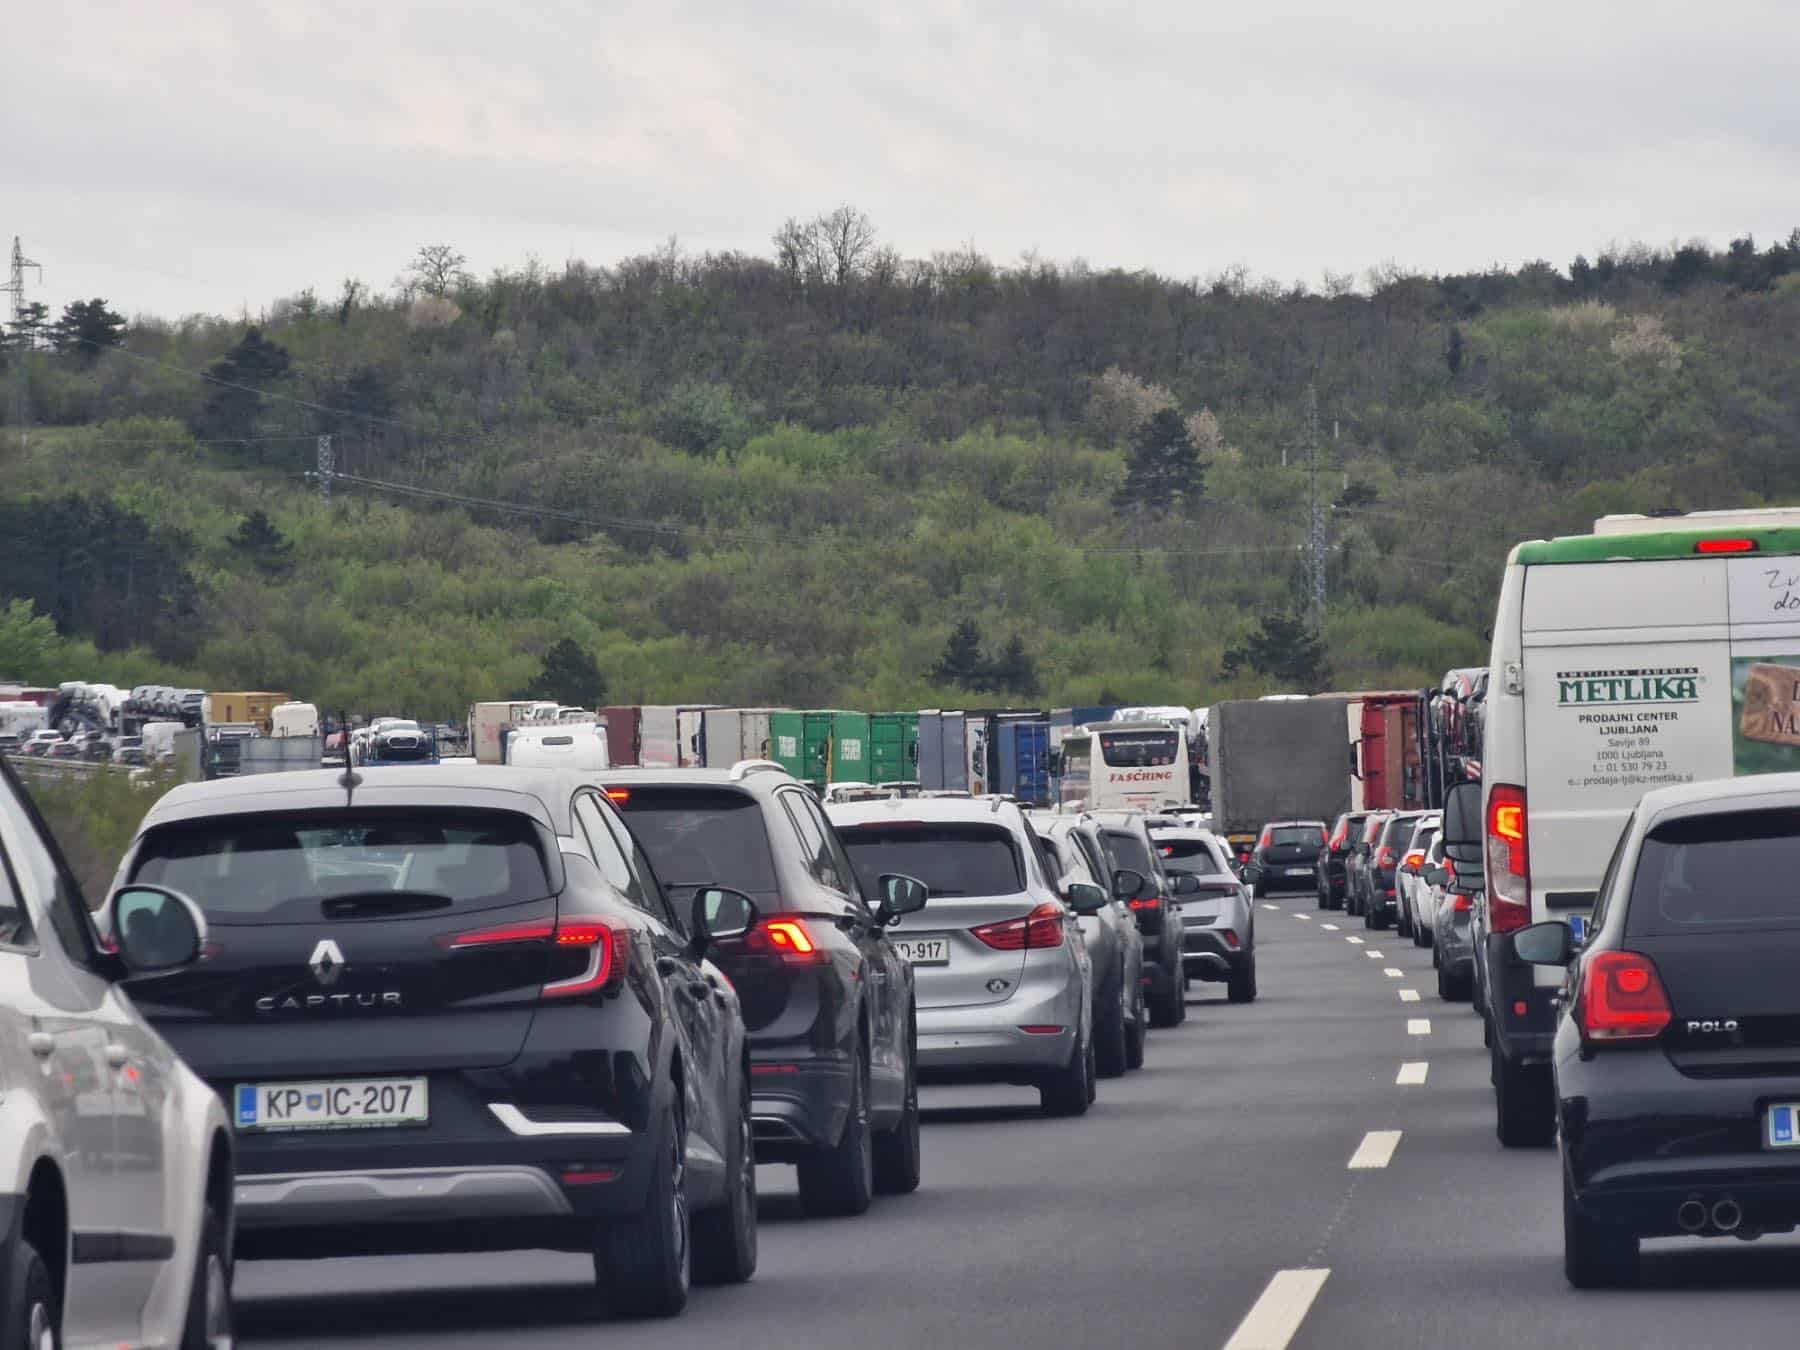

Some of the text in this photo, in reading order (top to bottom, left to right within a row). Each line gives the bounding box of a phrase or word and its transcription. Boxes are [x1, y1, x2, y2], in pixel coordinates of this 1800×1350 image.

[1558, 676, 1699, 703] METLIKA
[1578, 711, 1679, 723] PRODAJNI CENTER
[1599, 724, 1659, 735] LJUBLJANA
[1597, 751, 1619, 760] 1000
[1109, 771, 1173, 783] FASCHING
[897, 941, 942, 959] D-917
[255, 992, 401, 1010] CAPTUR
[1687, 1020, 1738, 1033] POLO
[266, 1084, 413, 1118] KP IC-207
